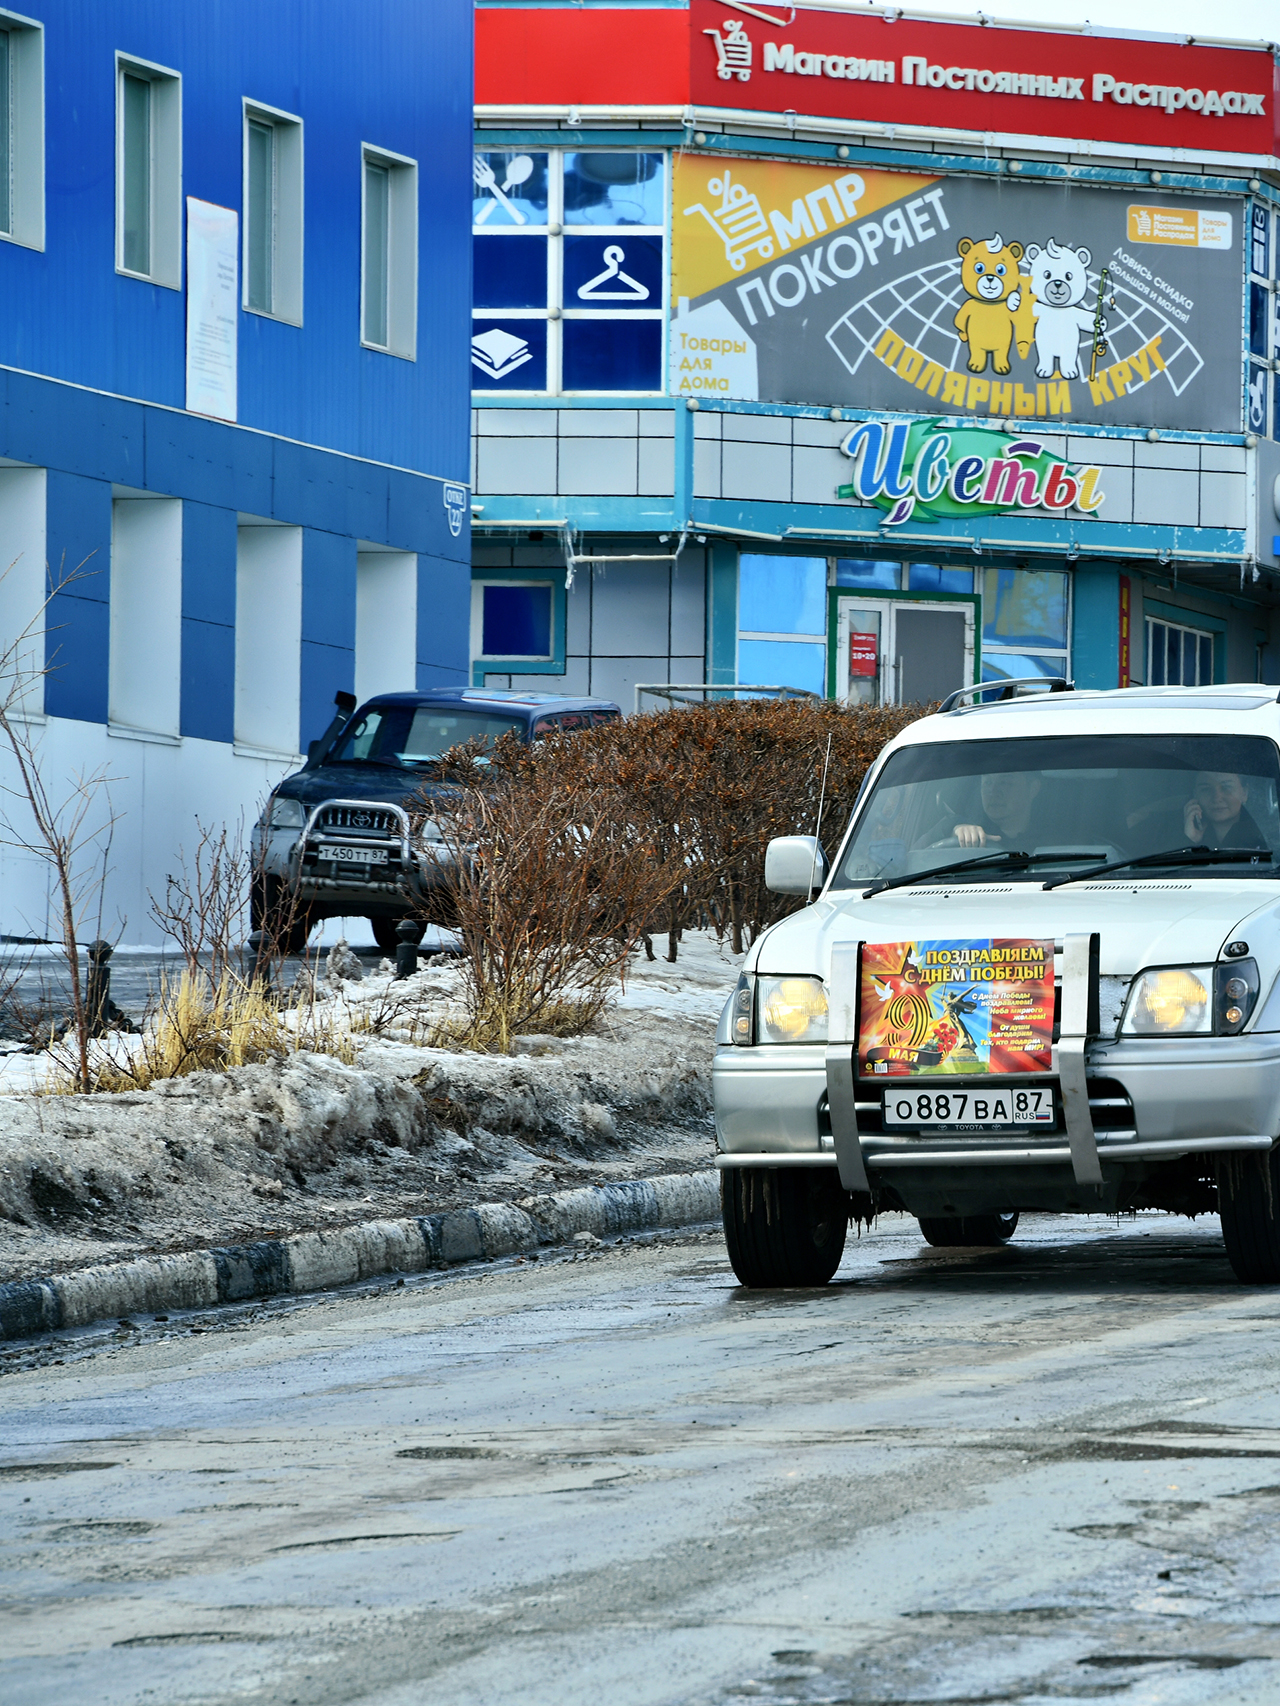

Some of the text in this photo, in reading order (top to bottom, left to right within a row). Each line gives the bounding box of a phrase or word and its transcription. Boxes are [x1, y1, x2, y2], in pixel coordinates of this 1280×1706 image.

[763, 41, 1266, 117] Магазин Постоянных Распродаж
[768, 173, 866, 251] МПР
[736, 188, 951, 326] ПОКОРЯЕТ
[1112, 246, 1195, 311] Ловись скидка
[1108, 260, 1190, 324] большая и малая!
[679, 332, 747, 356] Товары
[679, 356, 713, 372] для
[874, 328, 1167, 416] ПОЛЯРНЫЙ КРУГ
[679, 376, 730, 392] дома
[840, 421, 1106, 526] Цветы
[925, 947, 1044, 967] ПОЗДРАВЛЯЕМ
[904, 965, 1045, 985] С ДНЁМ ПОБЕДЫ!
[1000, 991, 1031, 1000] Победы
[883, 993, 930, 1047] 9
[1010, 1007, 1044, 1015] мирного
[888, 1048, 919, 1063] МАЯ
[895, 1092, 1043, 1120] О887ВА 87
[1015, 1112, 1035, 1120] RUS
